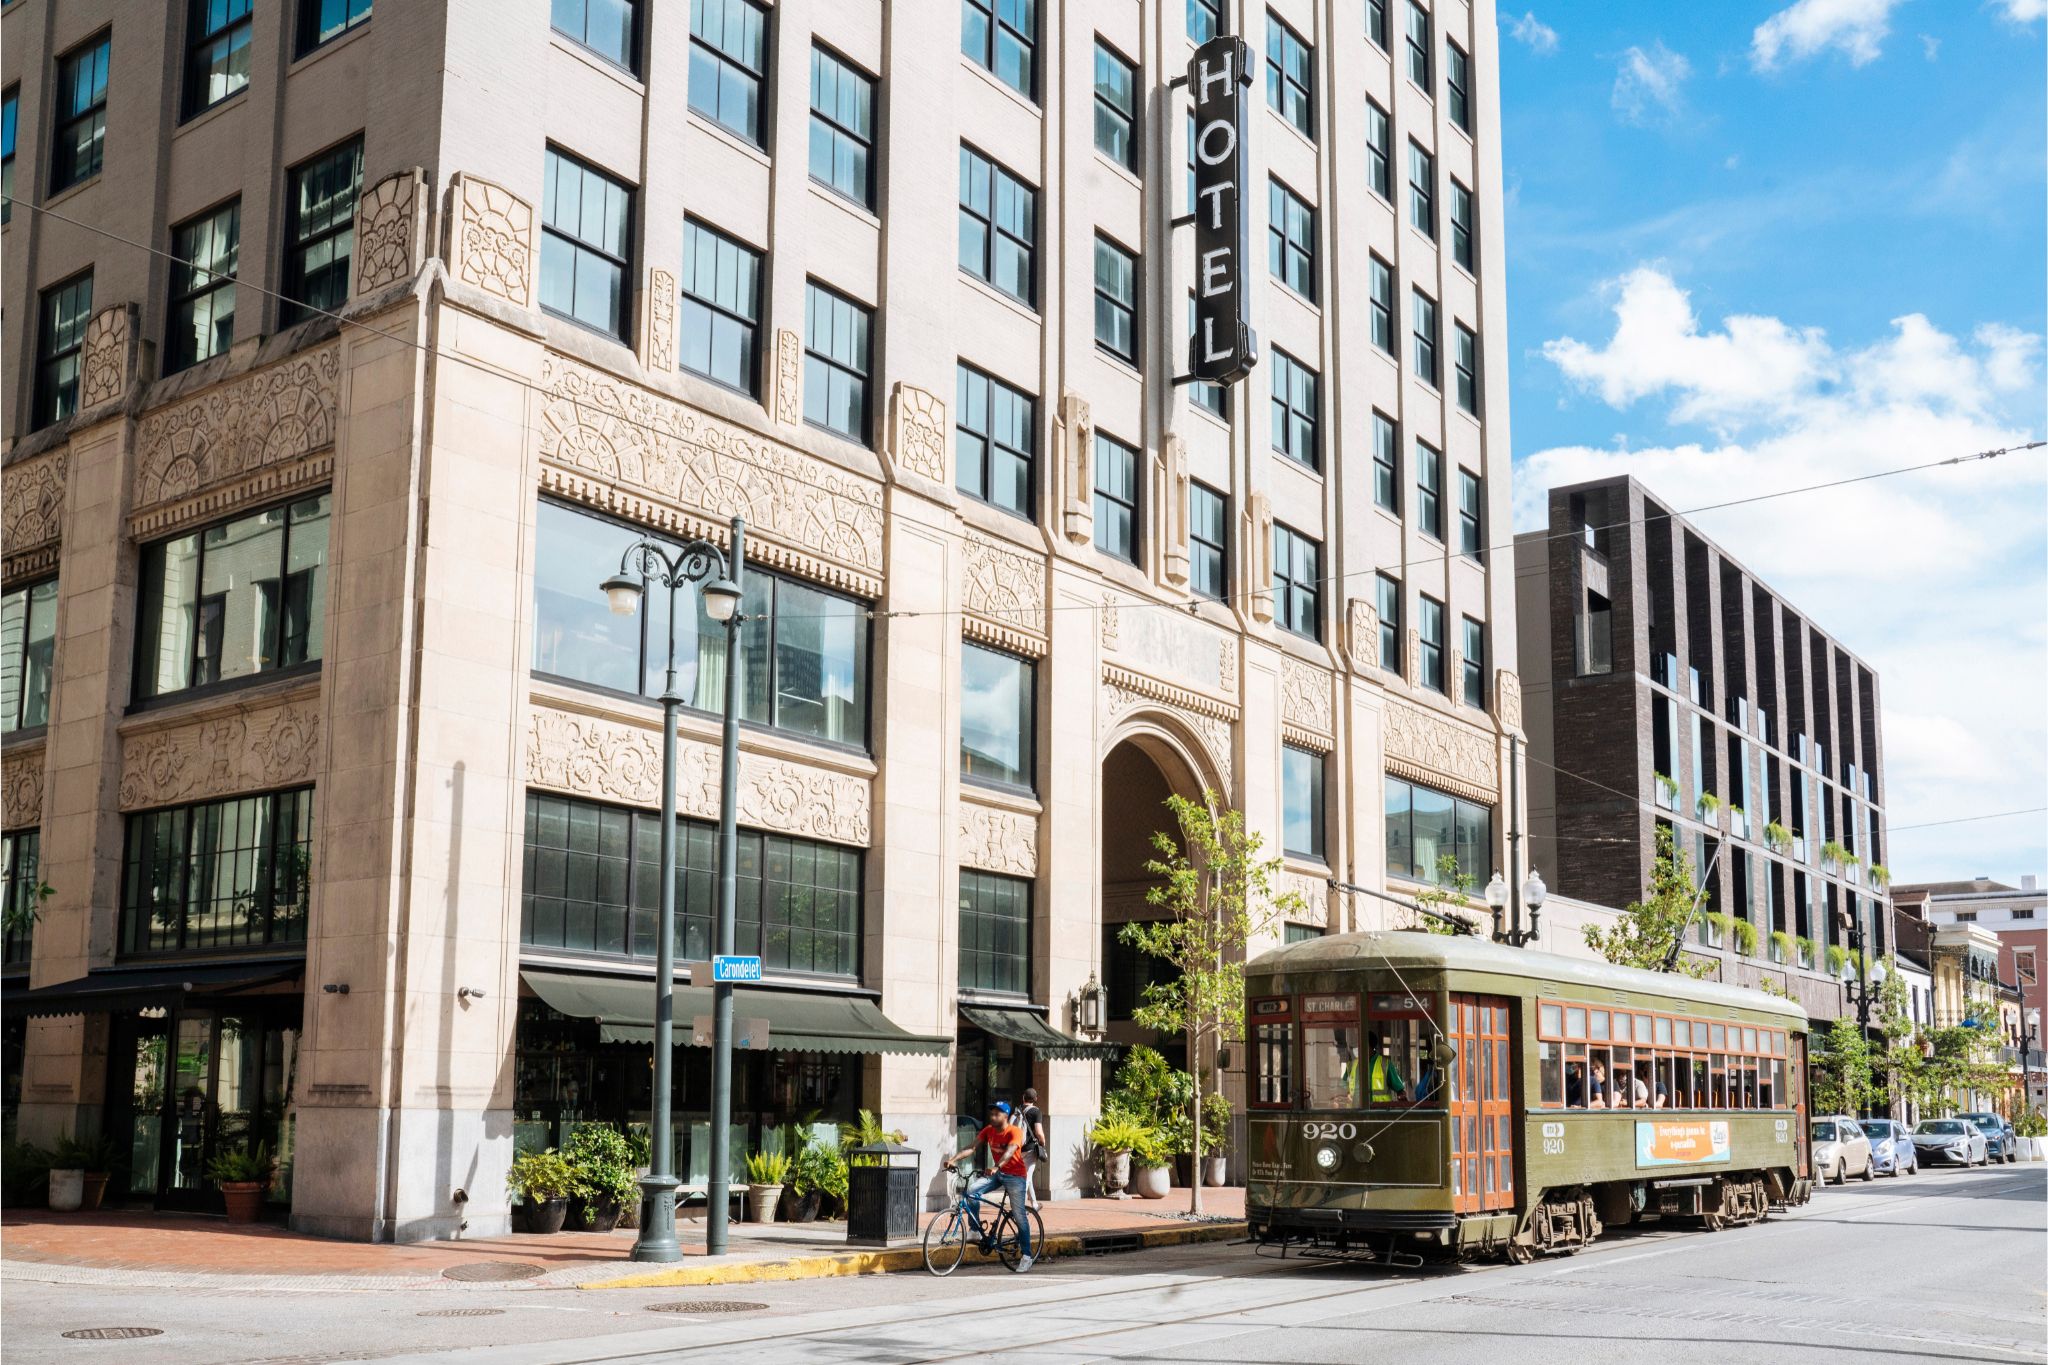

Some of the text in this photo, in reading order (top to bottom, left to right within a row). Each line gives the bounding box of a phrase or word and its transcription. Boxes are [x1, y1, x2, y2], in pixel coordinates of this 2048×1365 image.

[1197, 51, 1236, 363] HOTEL
[720, 959, 760, 978] Carondelet
[1306, 999, 1355, 1013] ST. CHARLES
[1303, 1122, 1357, 1140] 920
[1775, 1131, 1788, 1144] 920
[1544, 1138, 1564, 1155] 920
